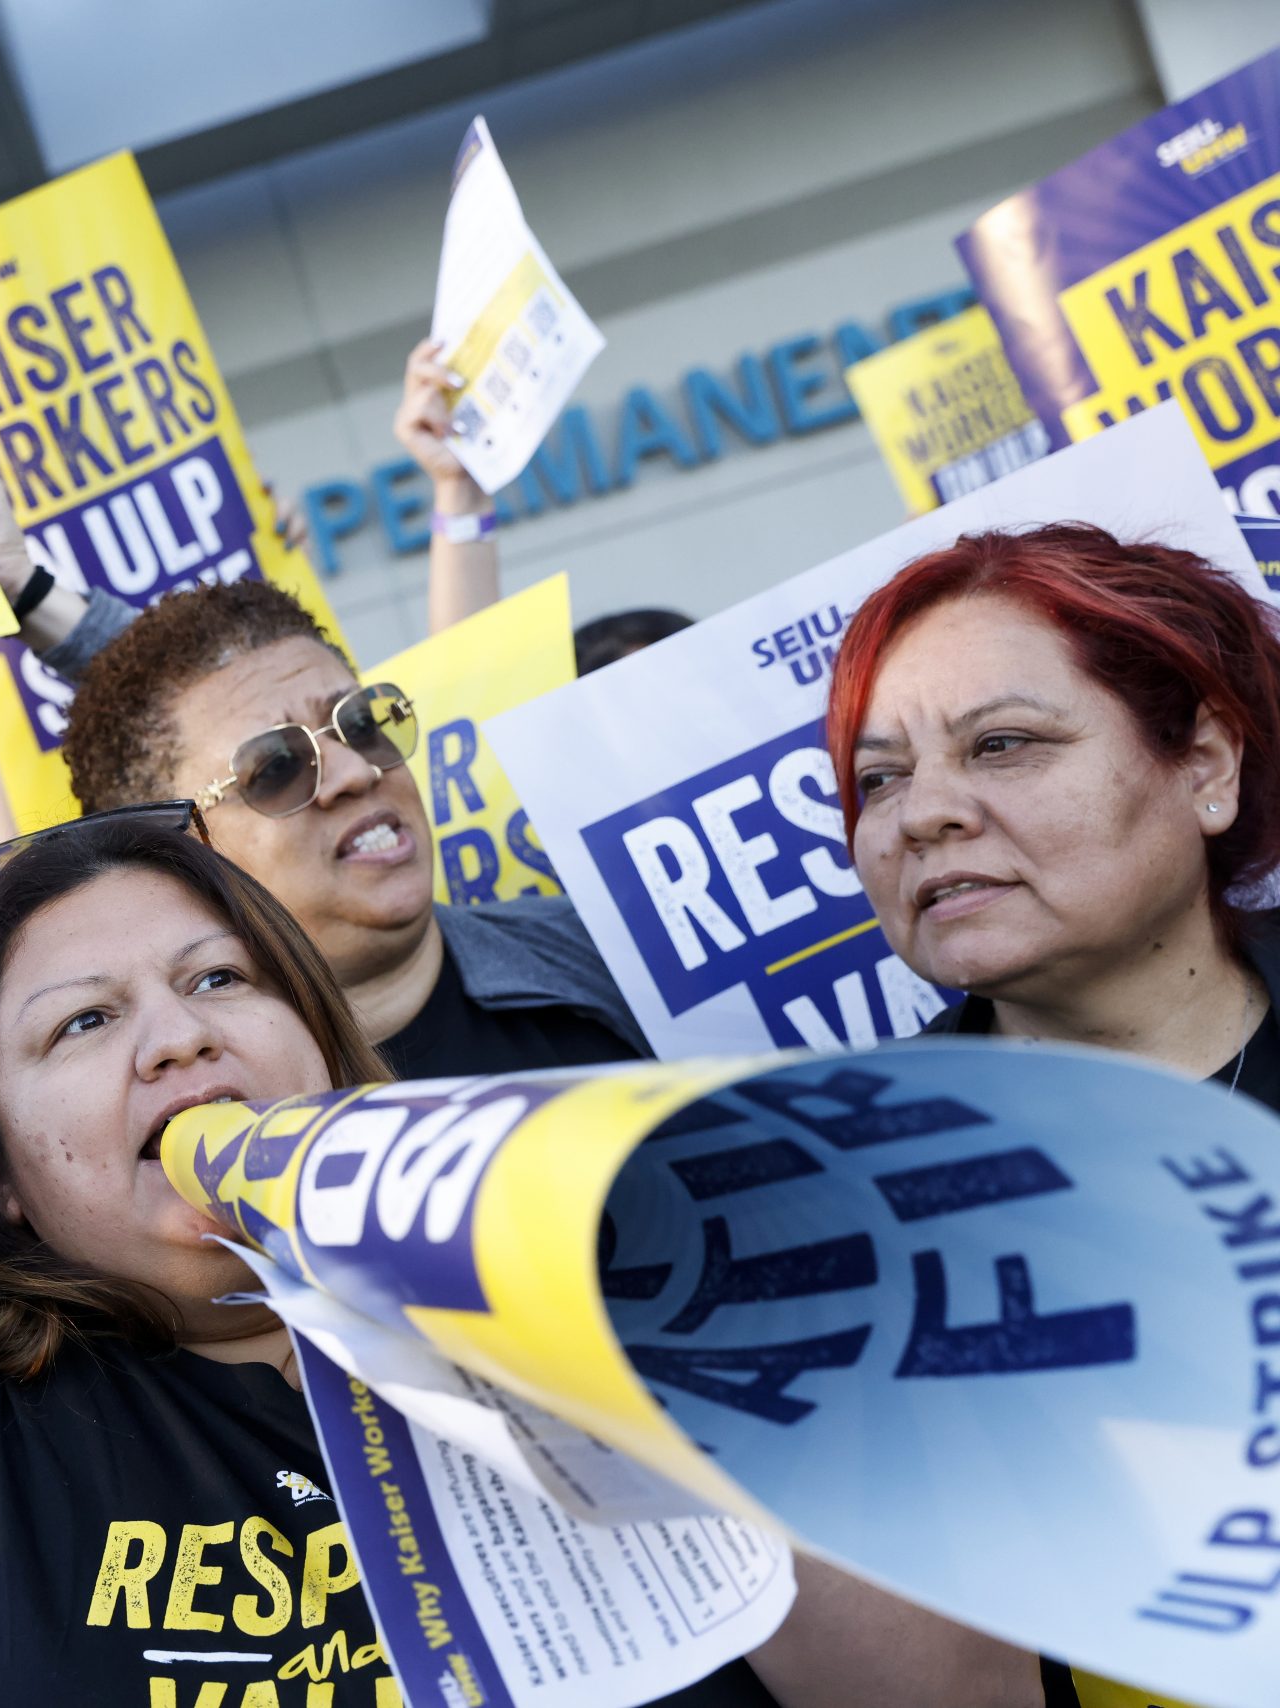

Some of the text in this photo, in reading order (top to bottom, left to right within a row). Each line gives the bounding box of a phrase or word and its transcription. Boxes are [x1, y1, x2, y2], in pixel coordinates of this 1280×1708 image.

[1105, 198, 1280, 367] KAIS
[81, 456, 223, 595] ULP
[622, 746, 866, 971] RES
[85, 1515, 363, 1637] RESP
[346, 1371, 454, 1650] Why Kaiser Worke
